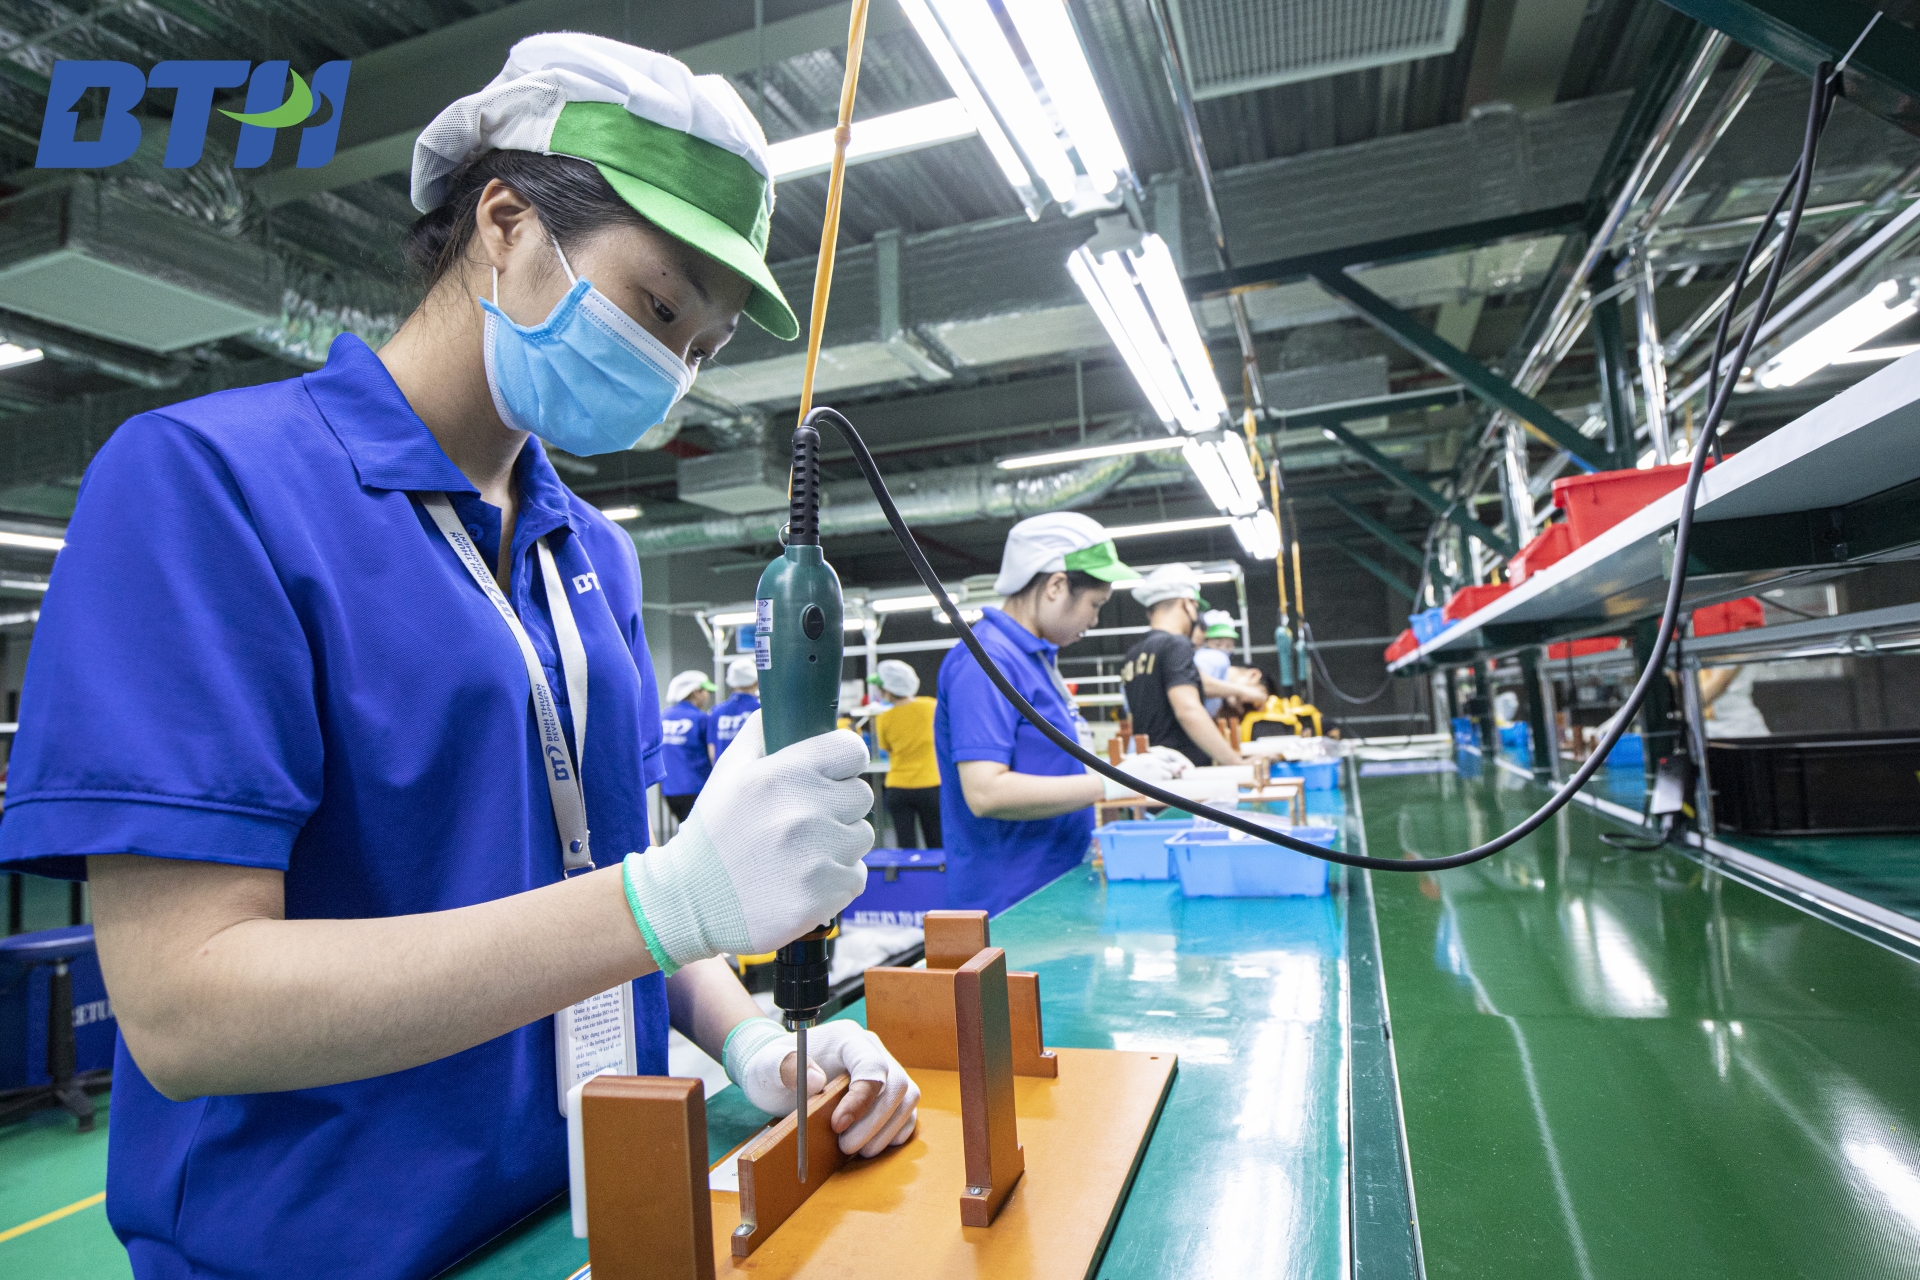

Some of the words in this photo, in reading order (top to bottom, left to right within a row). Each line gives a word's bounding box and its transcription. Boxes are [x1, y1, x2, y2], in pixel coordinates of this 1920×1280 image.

[449, 531, 473, 561] THUAN
[456, 532, 493, 585] DEVELOPMENT
[470, 562, 488, 584] BINH
[535, 683, 548, 717] THUAN
[540, 684, 560, 742] DEVELOPMENT
[544, 719, 554, 742] BINH
